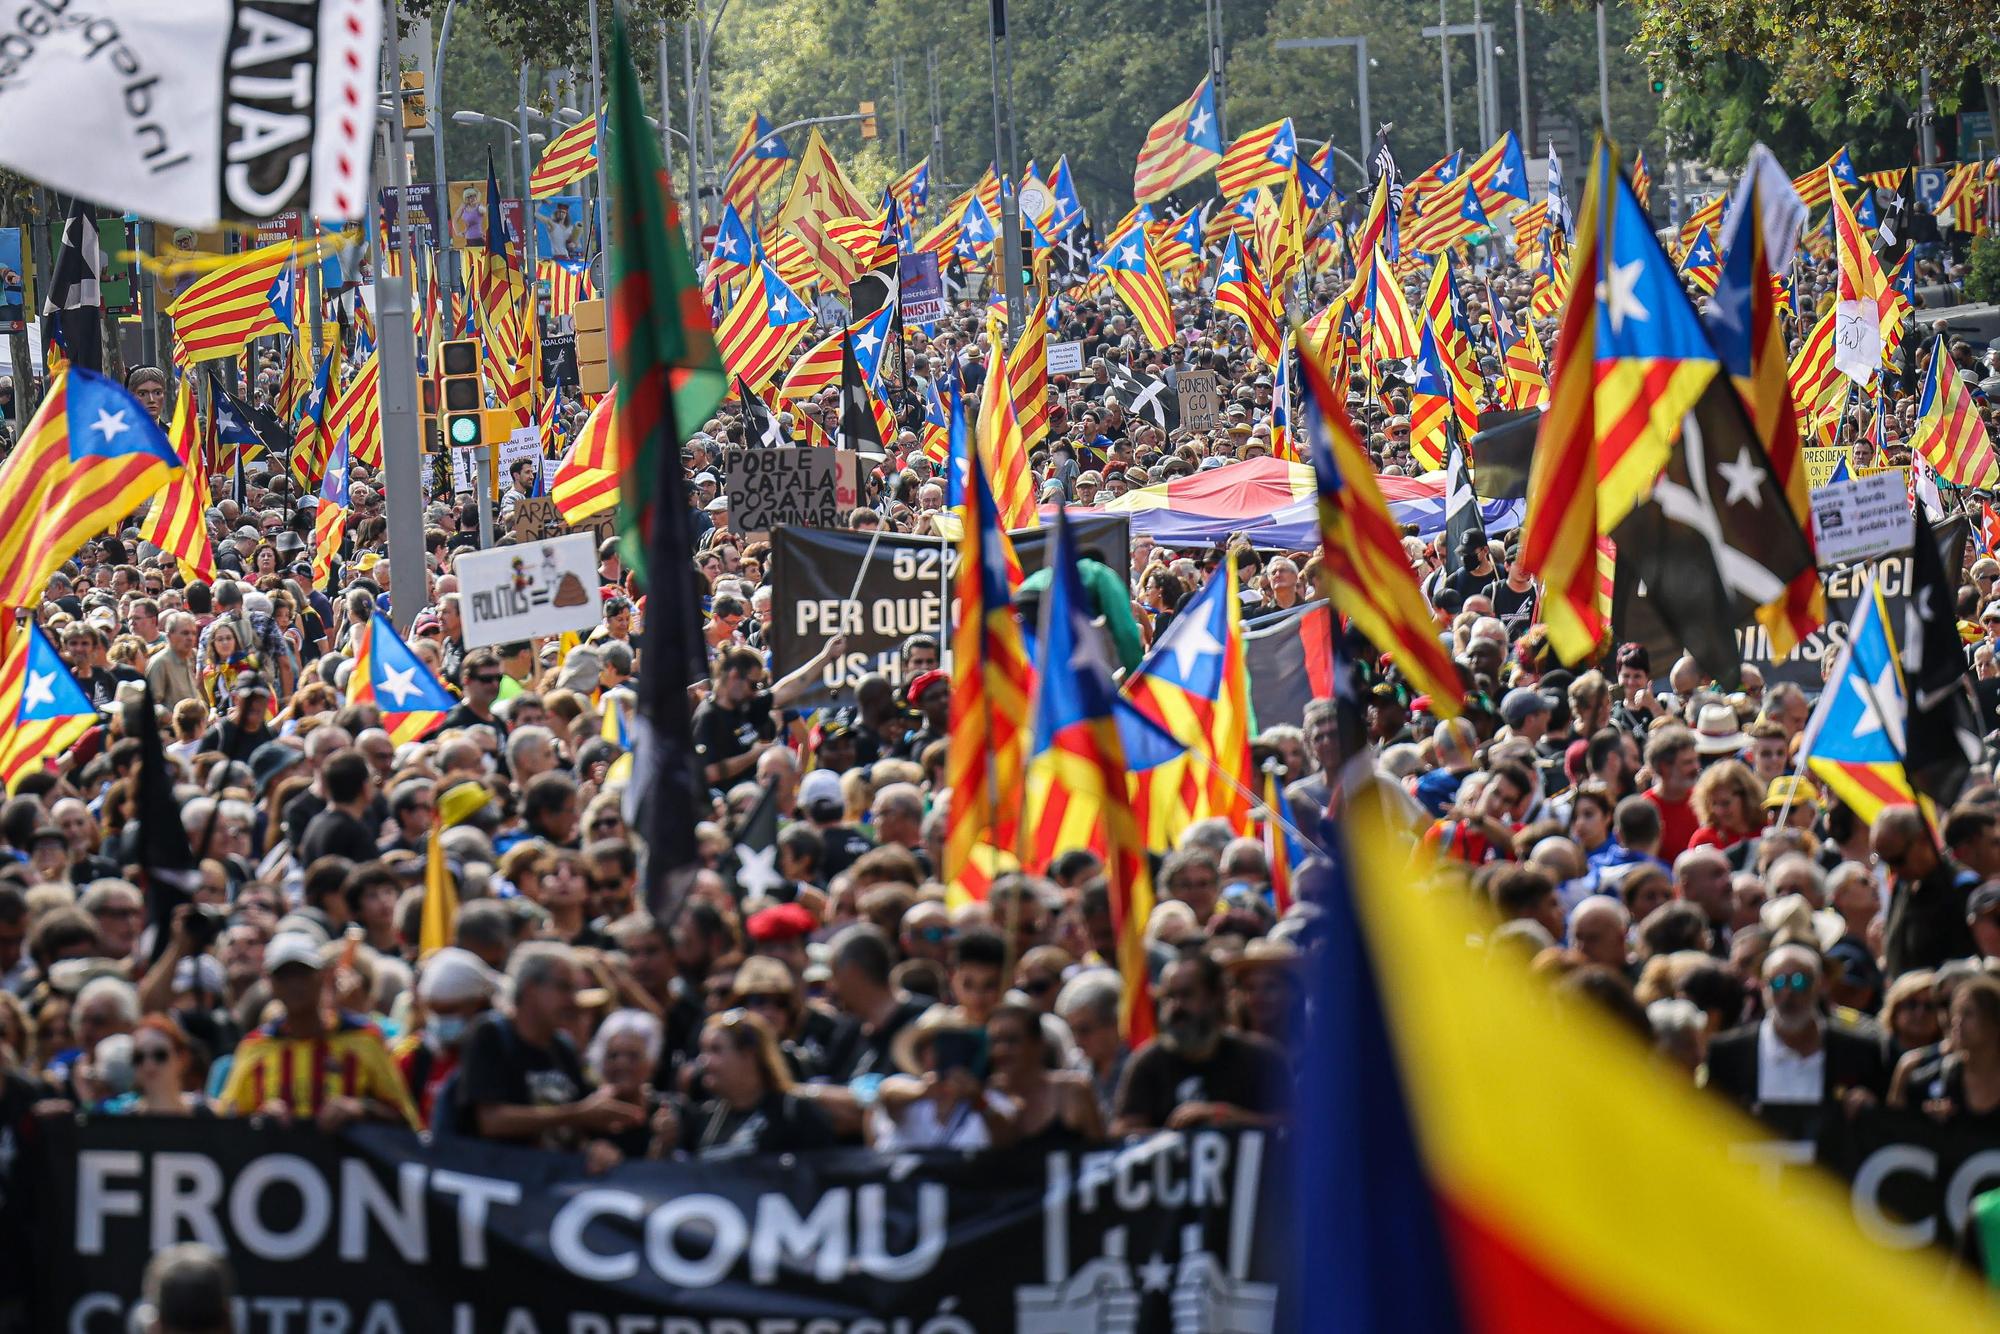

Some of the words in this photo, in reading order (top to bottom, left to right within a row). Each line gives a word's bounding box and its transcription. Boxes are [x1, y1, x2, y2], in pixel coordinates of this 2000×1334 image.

[257, 232, 288, 241] ARRIBA
[541, 336, 574, 347] ADALONA
[1177, 376, 1214, 394] GOVERN
[1188, 394, 1207, 410] GO
[1184, 413, 1215, 430] HOME
[728, 449, 812, 474] POBLE
[1804, 449, 1848, 463] PRESIDENT
[744, 468, 835, 493] CATALA
[1810, 465, 1821, 476] ON
[738, 508, 836, 532] CAMINAR
[796, 599, 865, 636] PER
[872, 590, 941, 638] QUÈ
[823, 651, 870, 689] US
[1078, 1129, 1230, 1213] FCCR
[75, 1149, 522, 1268] FRONT
[549, 1154, 950, 1289] COMÚ
